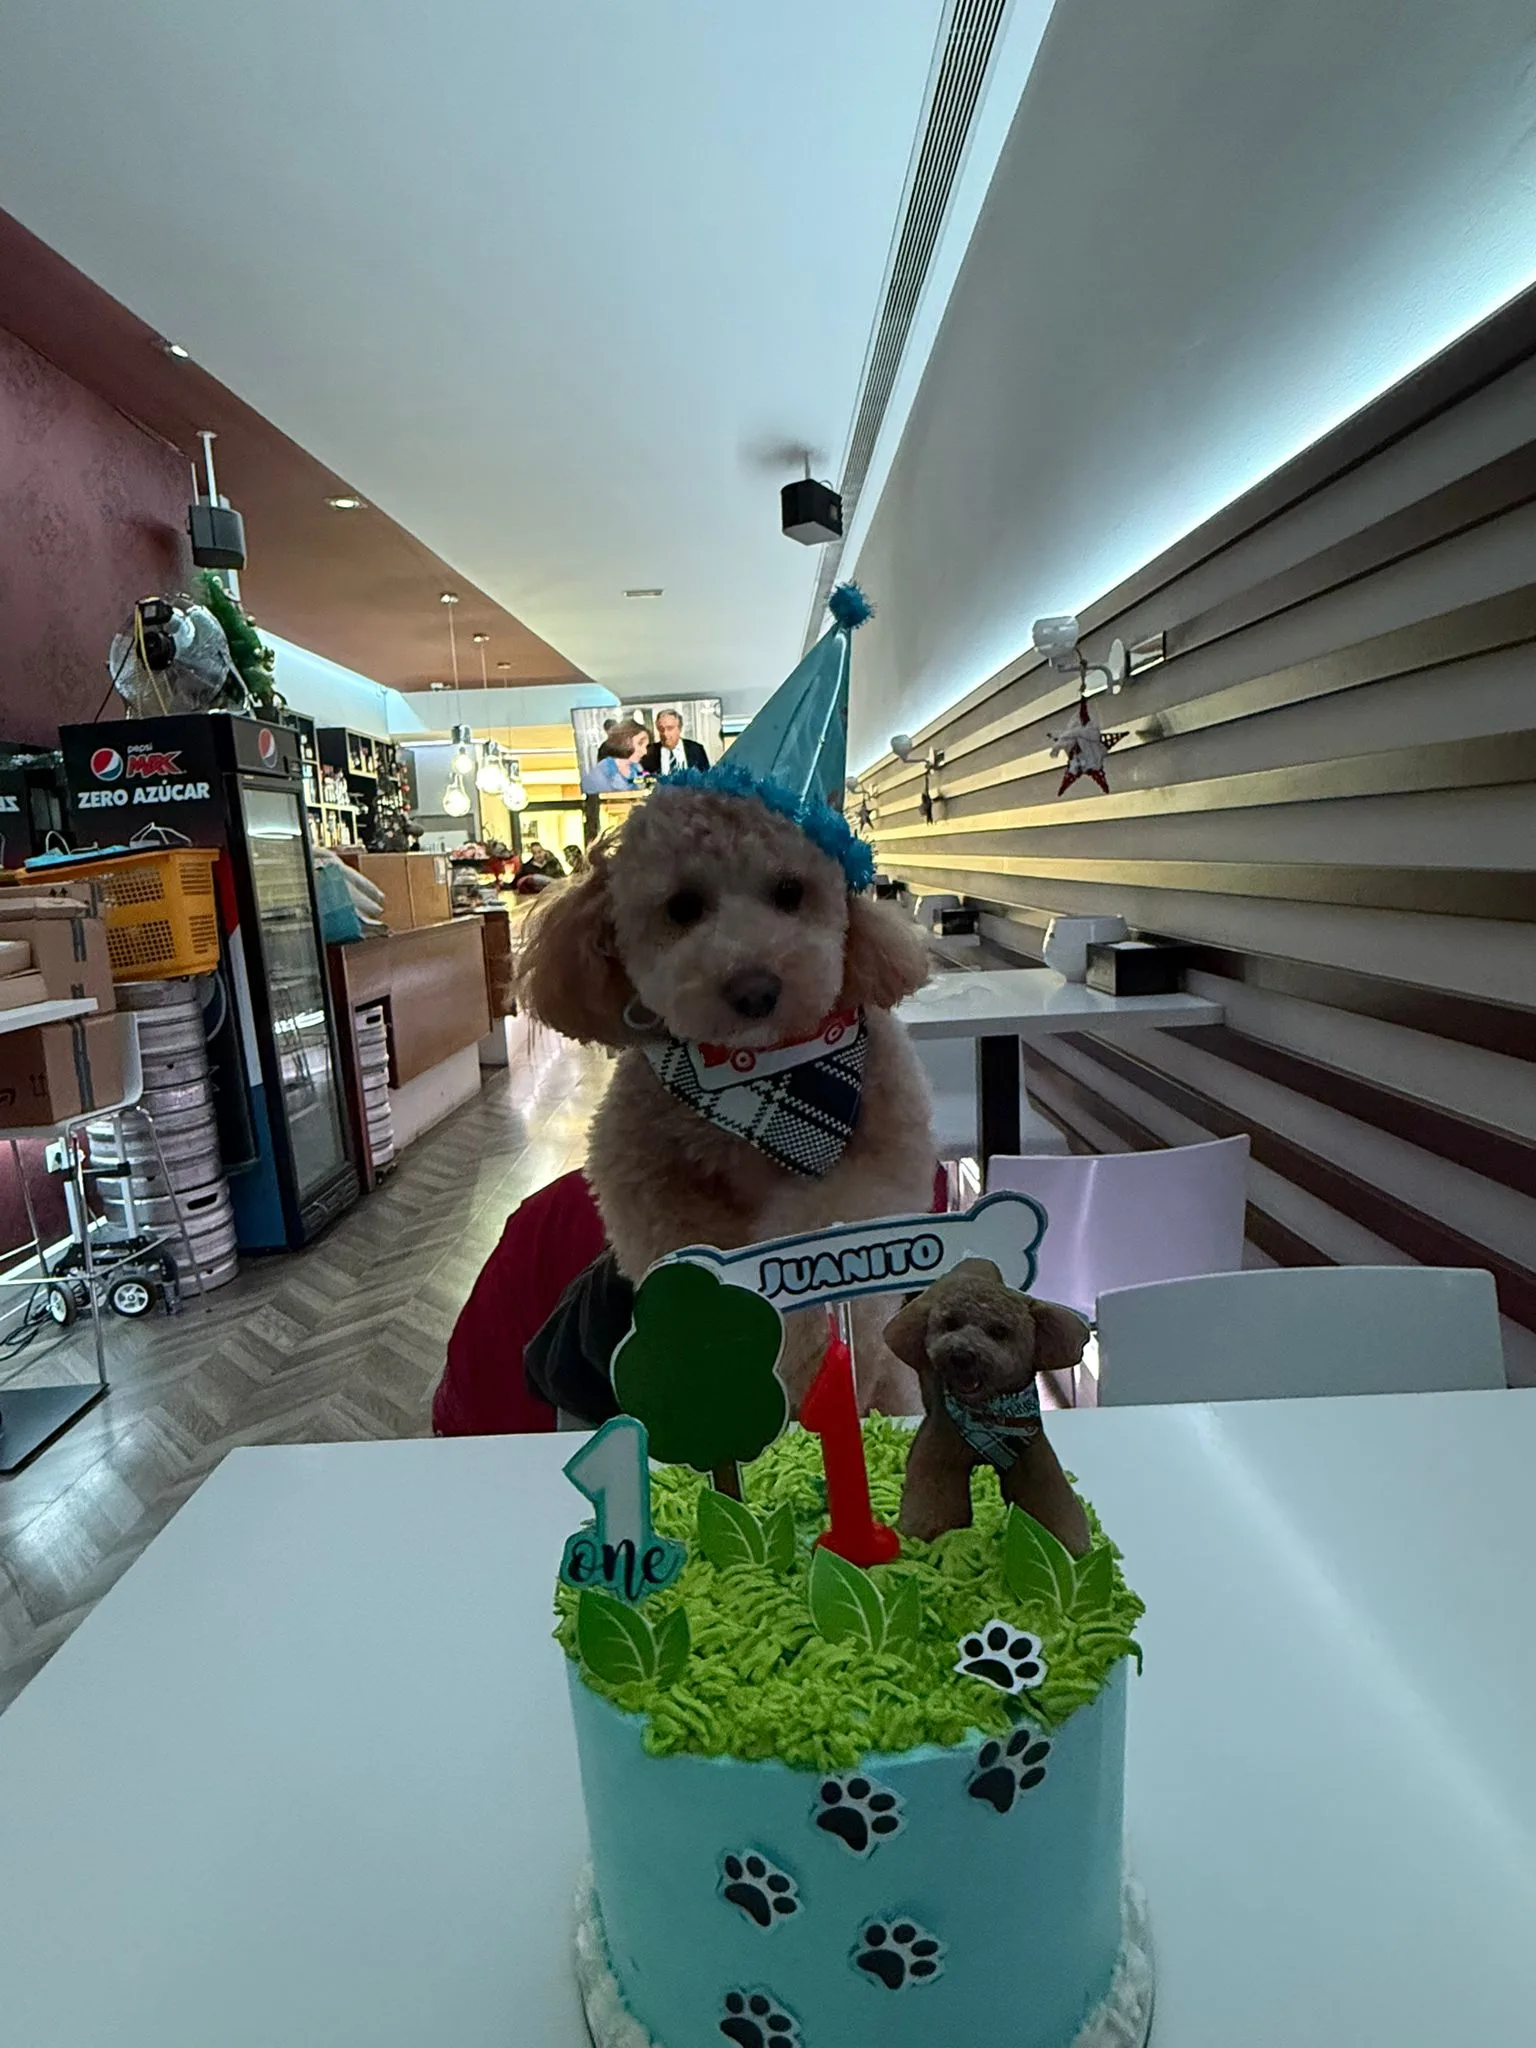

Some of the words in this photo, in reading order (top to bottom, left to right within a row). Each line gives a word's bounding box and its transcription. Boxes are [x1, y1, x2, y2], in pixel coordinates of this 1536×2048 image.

[77, 788, 129, 809] ZERO
[132, 779, 211, 805] AZÚCAR
[126, 750, 183, 779] MAX
[758, 1233, 944, 1299] JUANITO
[562, 1414, 650, 1548] 1
[567, 1539, 681, 1601] one
